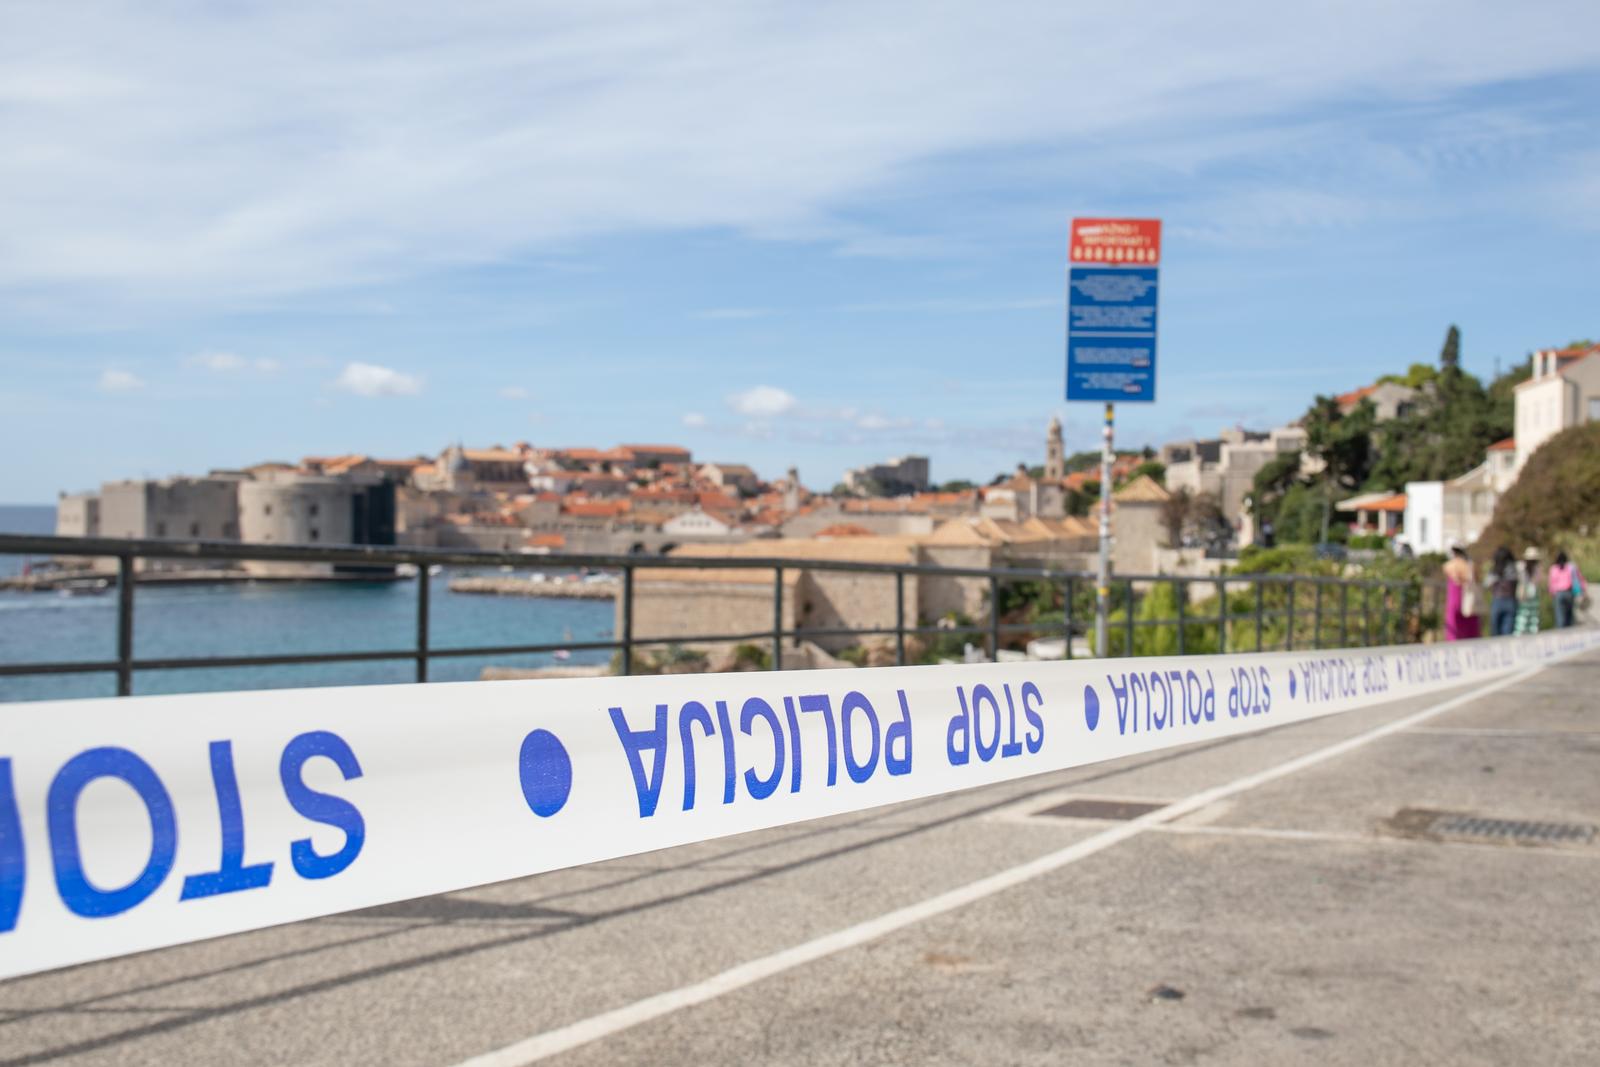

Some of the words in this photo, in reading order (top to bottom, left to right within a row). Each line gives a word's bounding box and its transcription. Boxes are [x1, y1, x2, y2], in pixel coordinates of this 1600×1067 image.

[947, 681, 1044, 766] STOP
[1107, 669, 1215, 735] POLICIJA
[1228, 666, 1271, 718] STOP
[608, 691, 912, 818] POLICIJA
